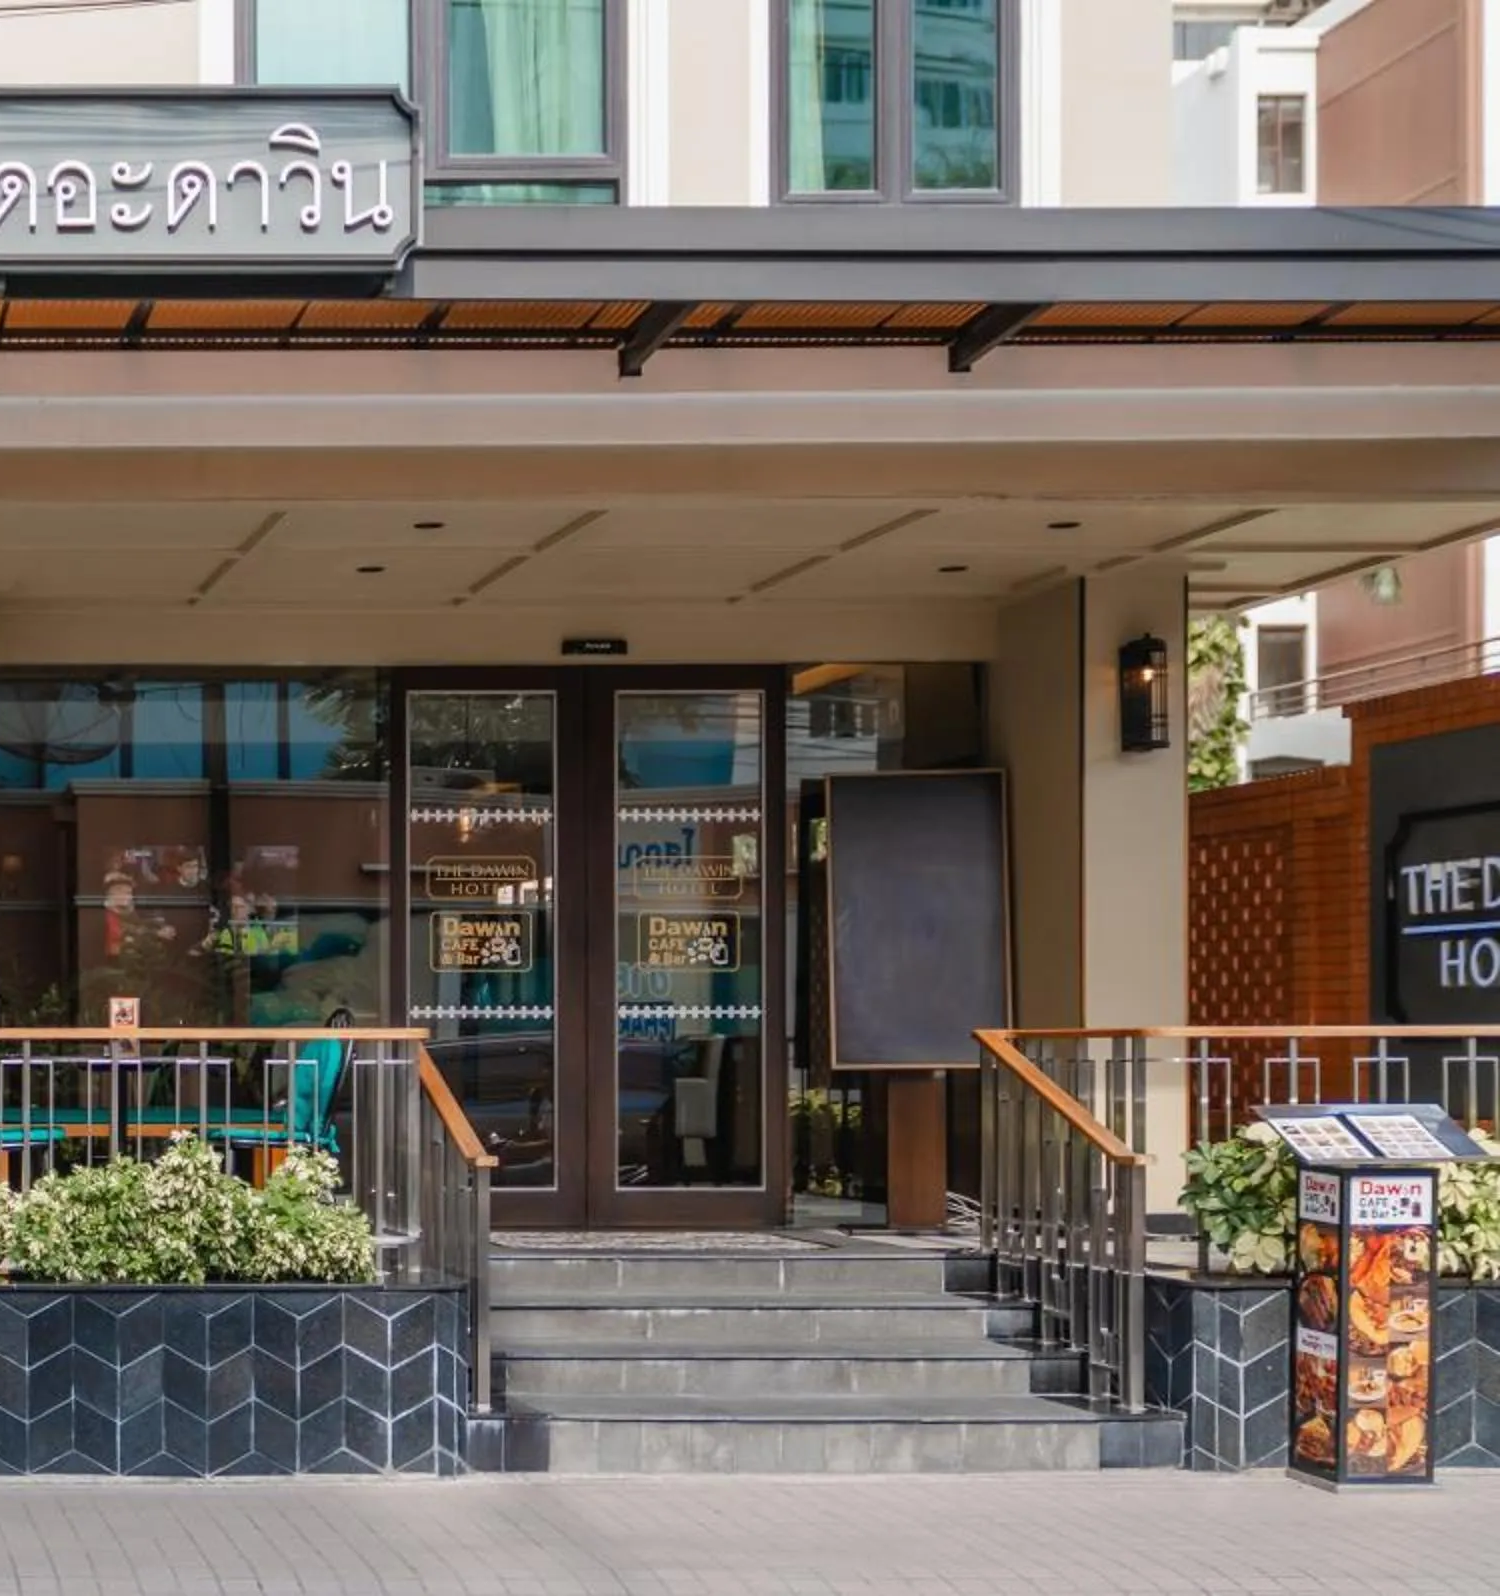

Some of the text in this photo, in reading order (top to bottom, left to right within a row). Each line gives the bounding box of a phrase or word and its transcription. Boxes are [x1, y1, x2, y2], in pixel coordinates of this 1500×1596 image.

[436, 863, 529, 877] THE DAWIN
[1401, 857, 1481, 915] THE
[443, 917, 521, 936] Dawin
[649, 916, 728, 936] Dawin
[441, 938, 479, 951] CAFE
[648, 938, 685, 951] CAFE
[456, 951, 480, 965] Bar
[663, 951, 685, 965] Bar
[1305, 1175, 1336, 1195] Dawin
[1360, 1181, 1422, 1196] Dawin
[1359, 1197, 1388, 1208] CAFE
